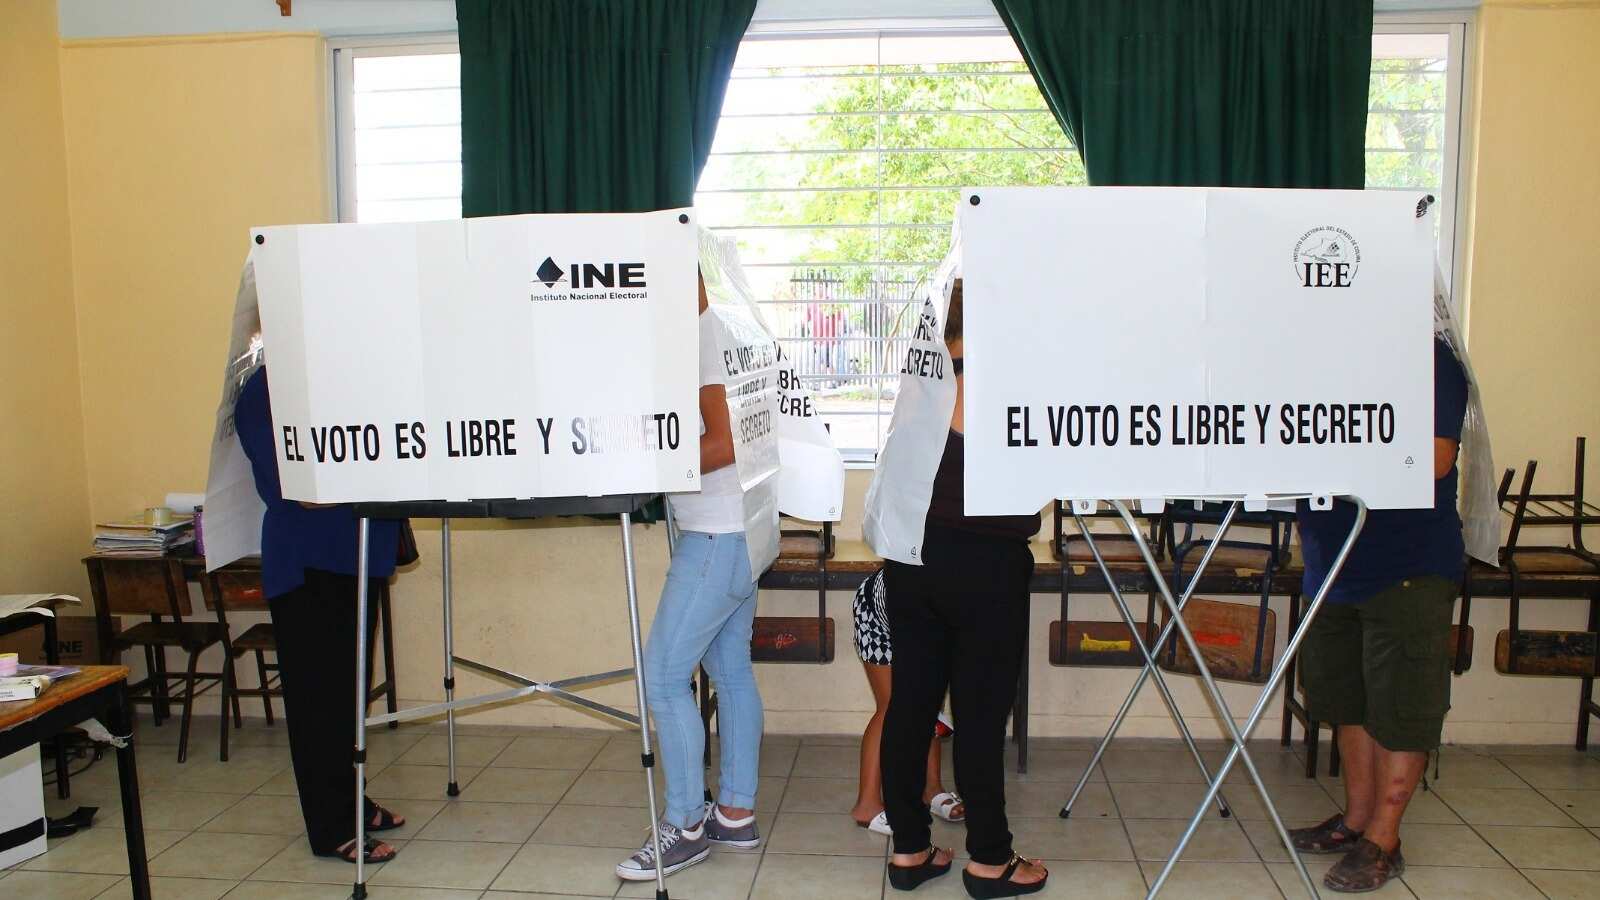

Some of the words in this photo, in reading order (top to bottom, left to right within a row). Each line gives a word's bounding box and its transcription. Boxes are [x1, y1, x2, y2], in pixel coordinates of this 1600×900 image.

[570, 262, 647, 288] INE
[1303, 262, 1352, 288] IEE
[530, 293, 567, 301] Instituto
[569, 292, 607, 300] Nacional
[609, 291, 647, 299] Electoral
[723, 349, 739, 377] EL
[900, 347, 944, 380] CRETO
[777, 391, 818, 417] CRE
[740, 409, 771, 444] SECRETO
[1007, 406, 1039, 447] EL
[1047, 405, 1119, 447] VOTO
[1130, 404, 1161, 446] ES
[1172, 404, 1245, 445] LIBRE
[1255, 404, 1271, 444] Y
[1279, 402, 1394, 445] SECRETO
[282, 425, 305, 462] EL
[311, 424, 380, 463] VOTO
[395, 421, 426, 459] ES
[447, 419, 516, 457] LIBRE
[536, 417, 553, 455] Y
